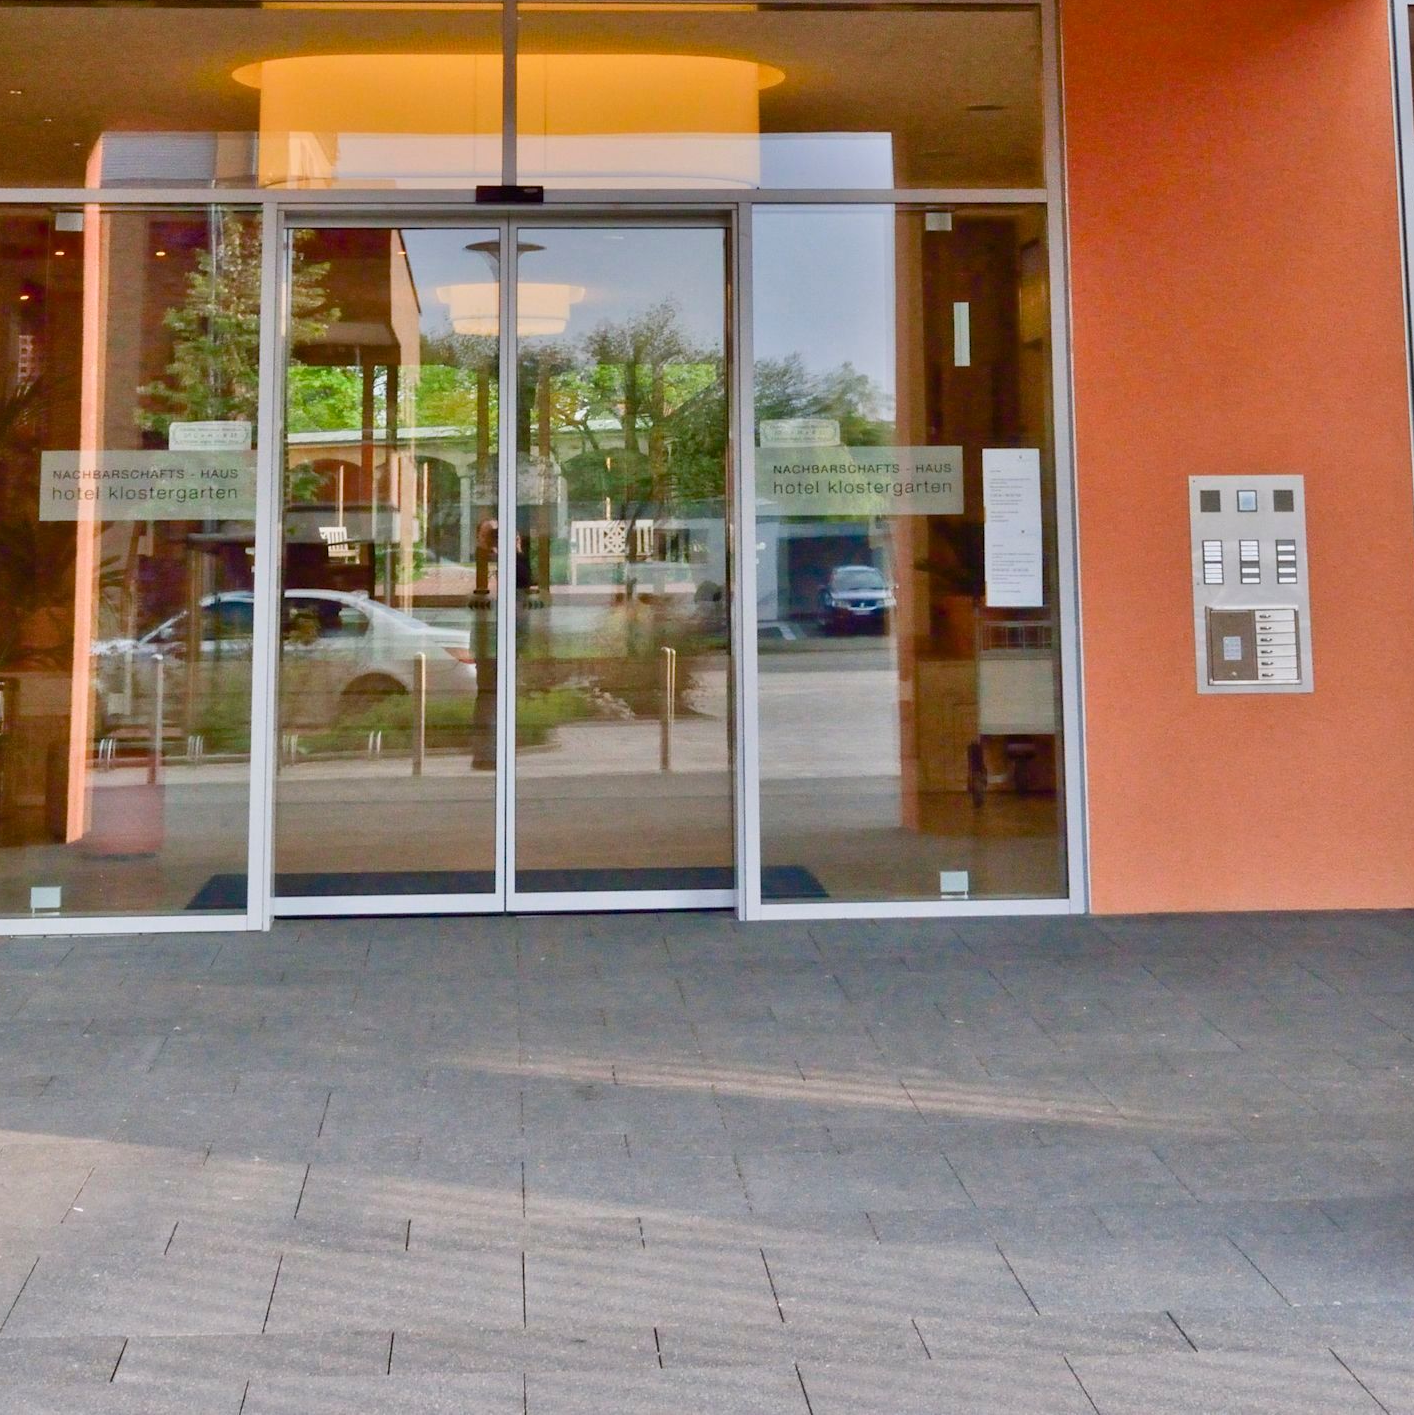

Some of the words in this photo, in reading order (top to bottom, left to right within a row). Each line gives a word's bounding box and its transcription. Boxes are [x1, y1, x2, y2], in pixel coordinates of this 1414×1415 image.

[52, 469, 185, 480] NACHBARSCHAFTS
[201, 469, 239, 479] HAUS
[773, 463, 900, 475] NACHBARSCHAFTS
[915, 463, 952, 473] HAUS
[108, 486, 238, 503] klostergarten
[773, 481, 819, 495] hotel
[828, 480, 952, 497] klostergarten
